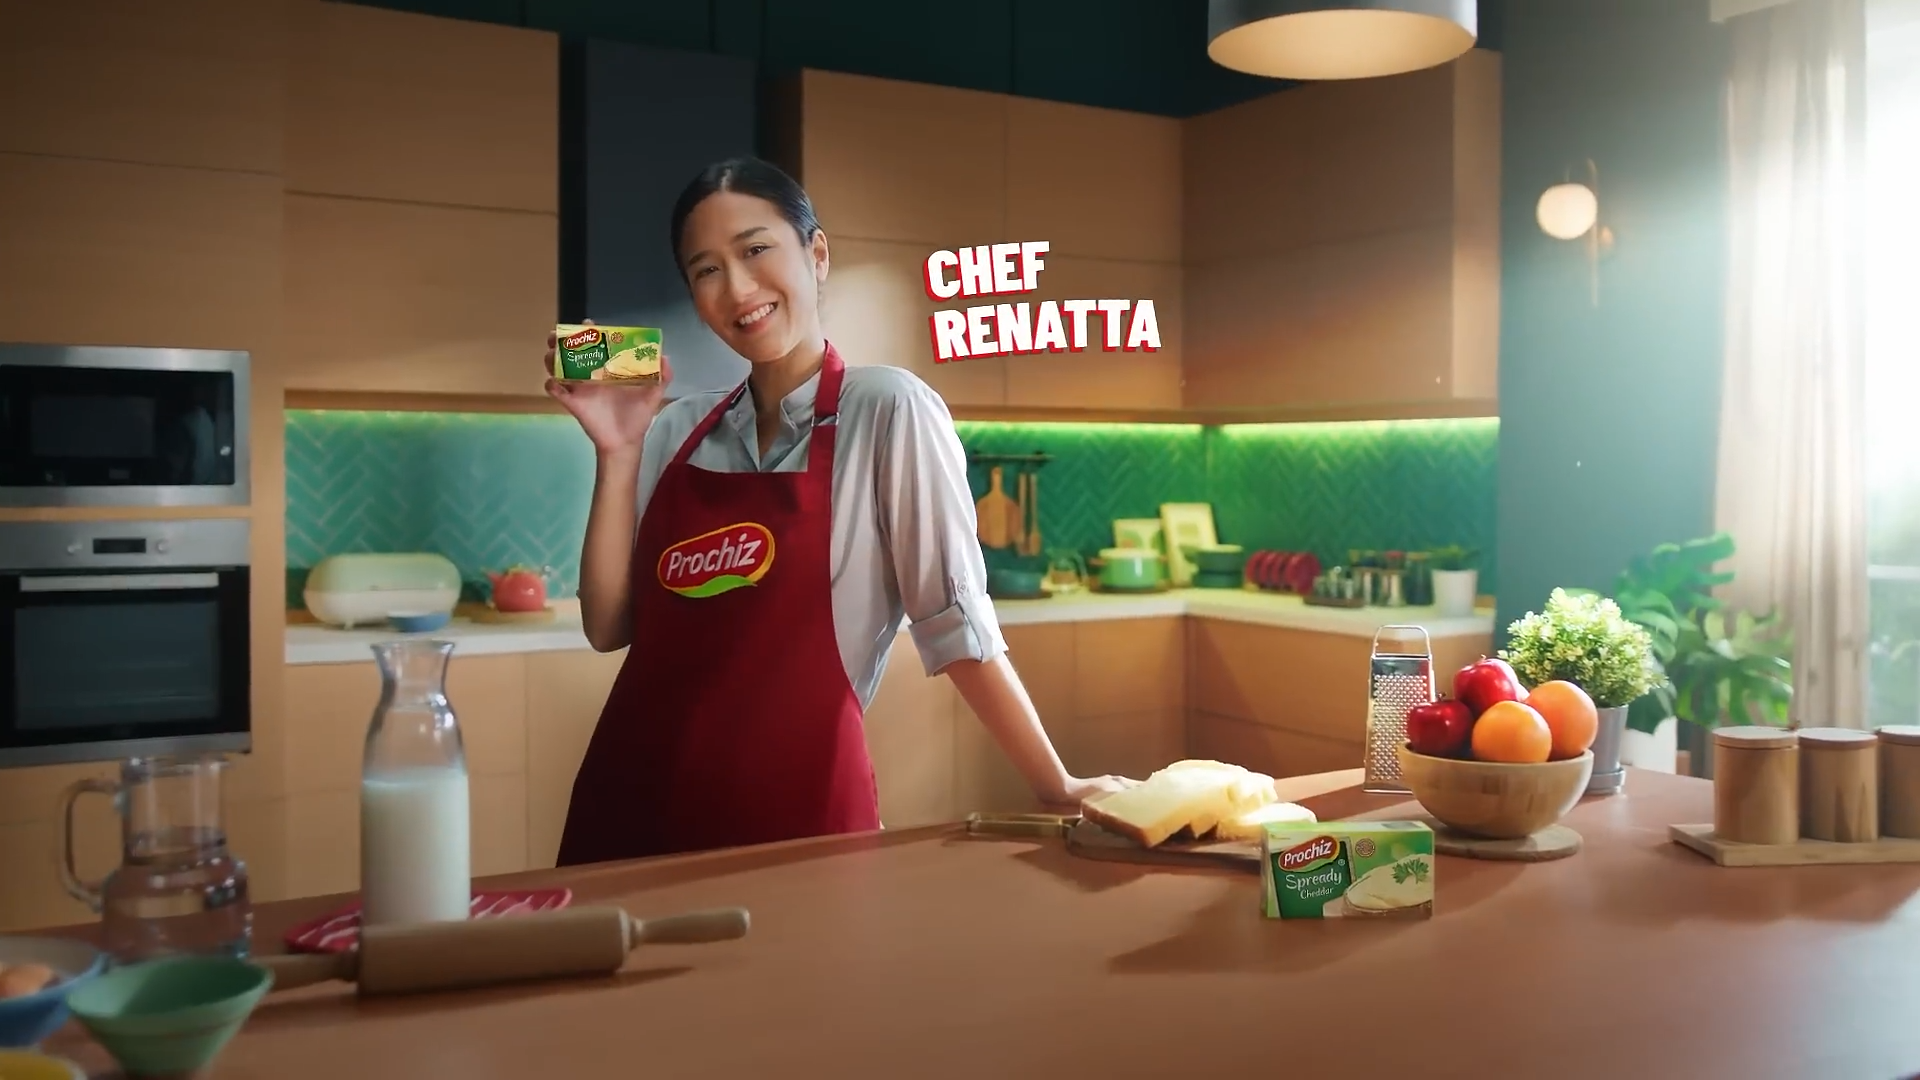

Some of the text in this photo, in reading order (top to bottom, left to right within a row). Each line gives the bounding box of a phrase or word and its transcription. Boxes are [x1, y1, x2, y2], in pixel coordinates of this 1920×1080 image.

[566, 330, 598, 348] Prochiz
[666, 532, 762, 581] Prochiz
[1284, 838, 1333, 867] Prochiz
[1285, 868, 1342, 891] Spready
[1300, 887, 1334, 900] Cheddar
